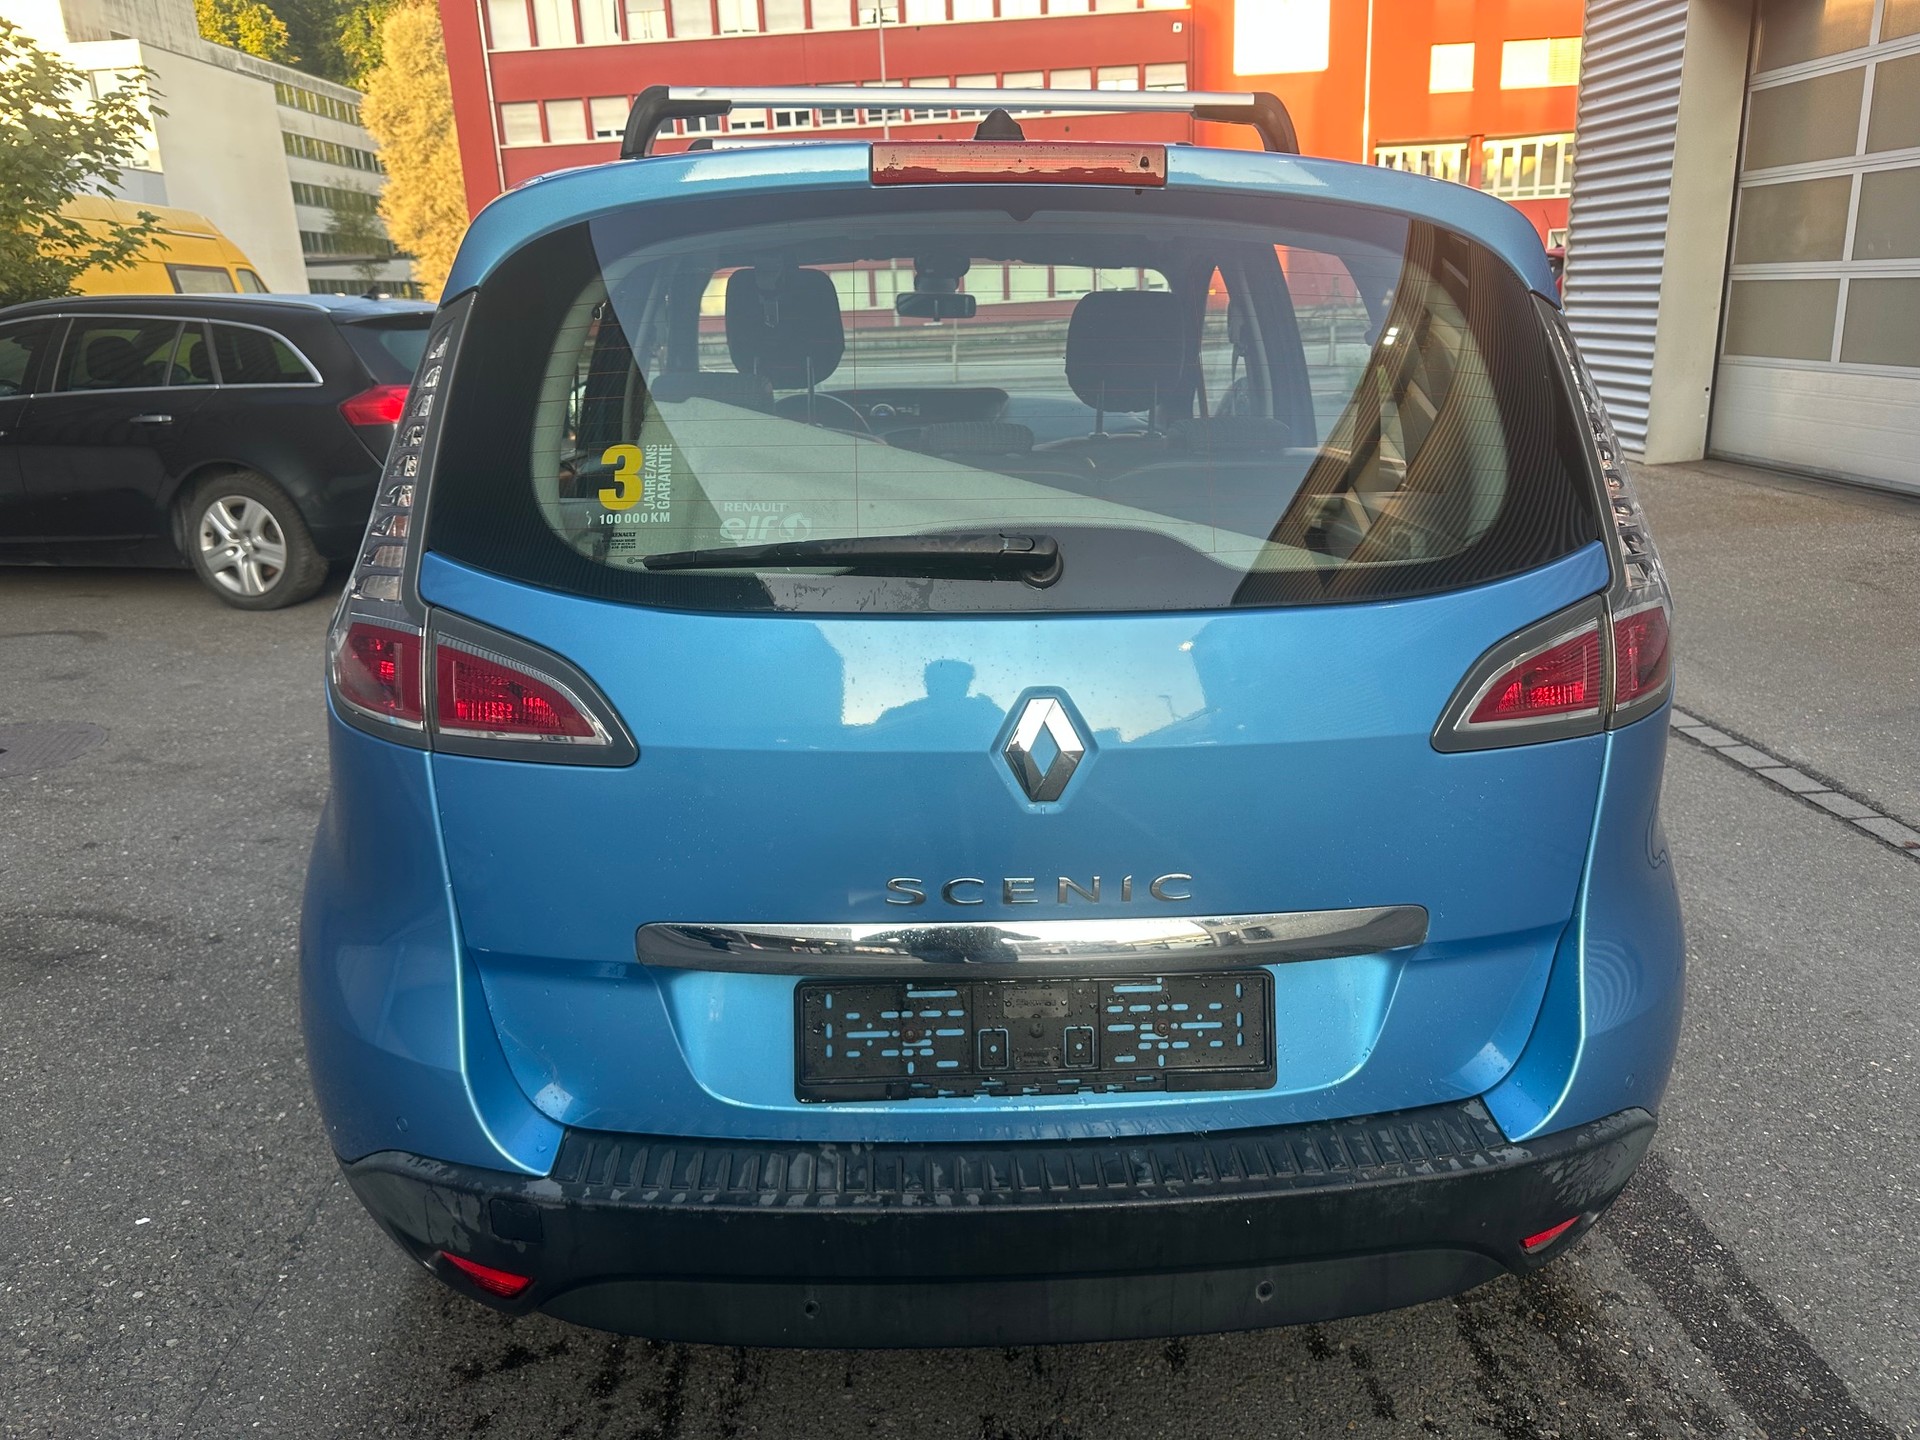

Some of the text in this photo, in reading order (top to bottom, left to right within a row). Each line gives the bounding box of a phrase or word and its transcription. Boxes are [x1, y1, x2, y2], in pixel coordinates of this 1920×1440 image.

[598, 444, 642, 511] 3
[644, 444, 658, 510] JAHRE/ANS
[657, 444, 673, 510] GARANTIE
[599, 511, 670, 525] 100 000 KM
[724, 502, 786, 512] RENAULT
[720, 515, 778, 540] elf
[885, 871, 1194, 906] SCENIC
